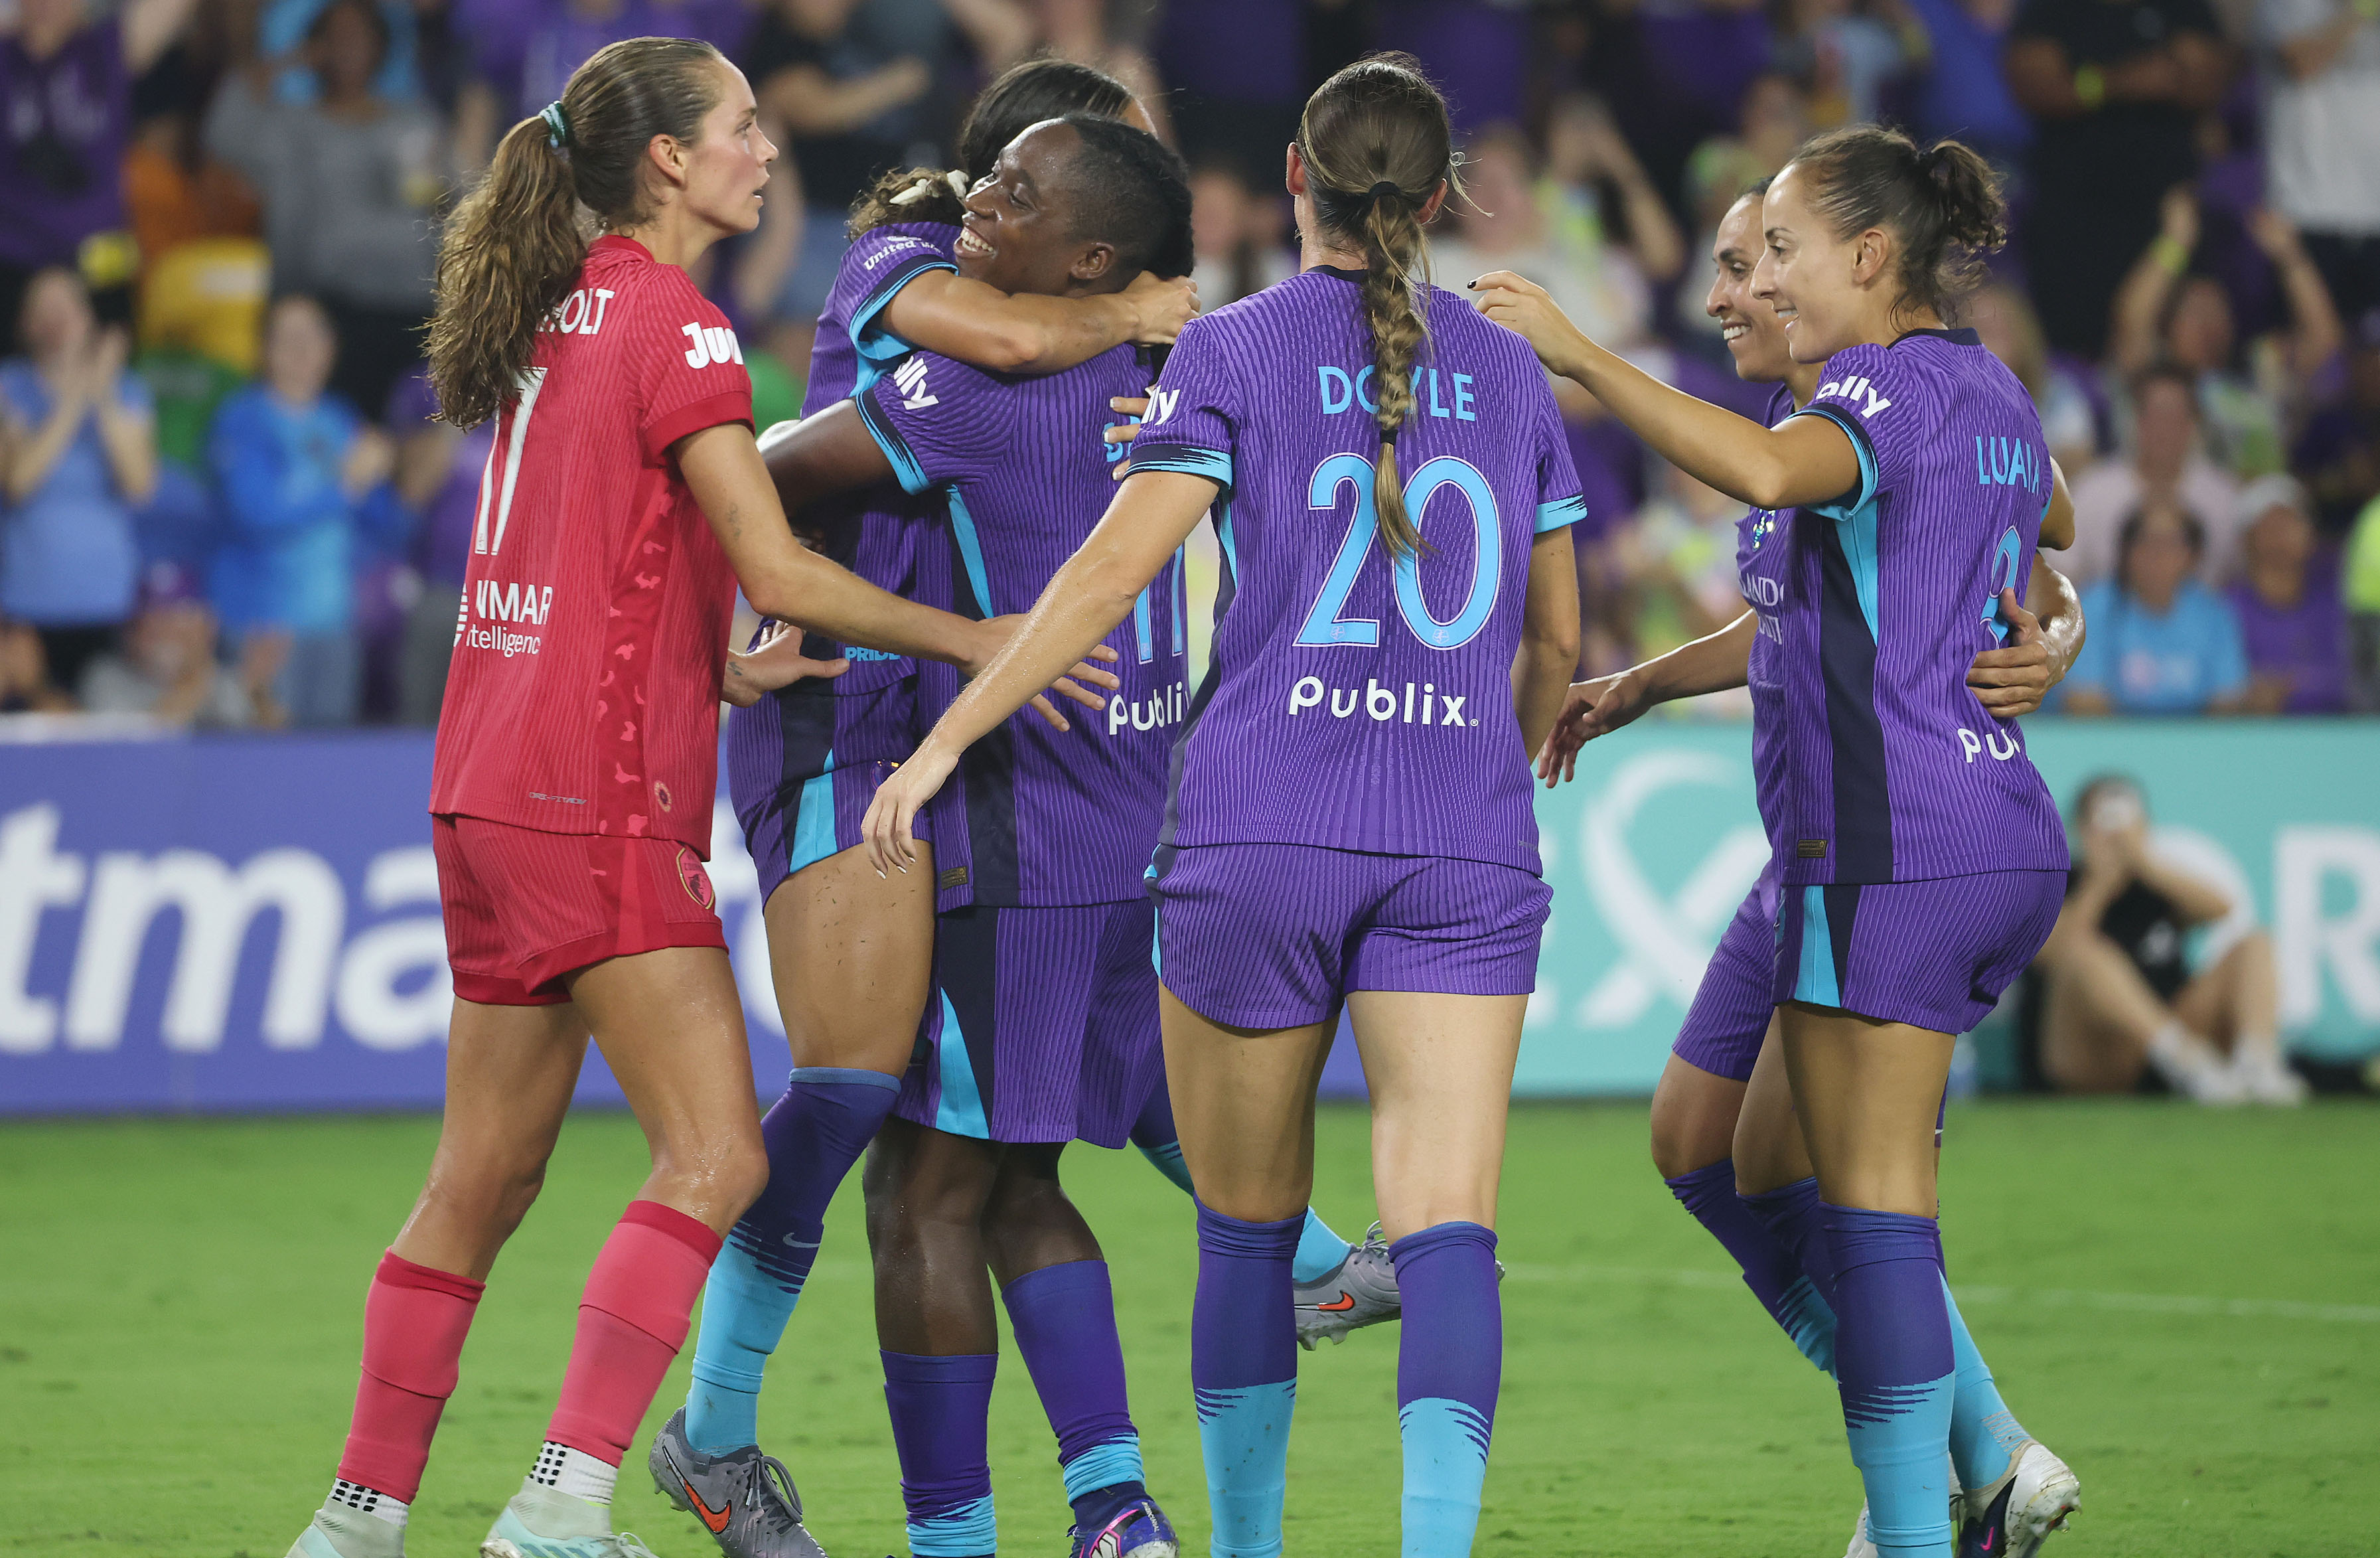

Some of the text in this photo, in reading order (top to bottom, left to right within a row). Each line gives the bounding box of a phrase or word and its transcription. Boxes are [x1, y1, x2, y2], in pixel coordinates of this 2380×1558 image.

[864, 240, 917, 271] United
[1816, 375, 1892, 419] ally
[1294, 452, 1502, 651] 20
[1109, 681, 1189, 736] Publi
